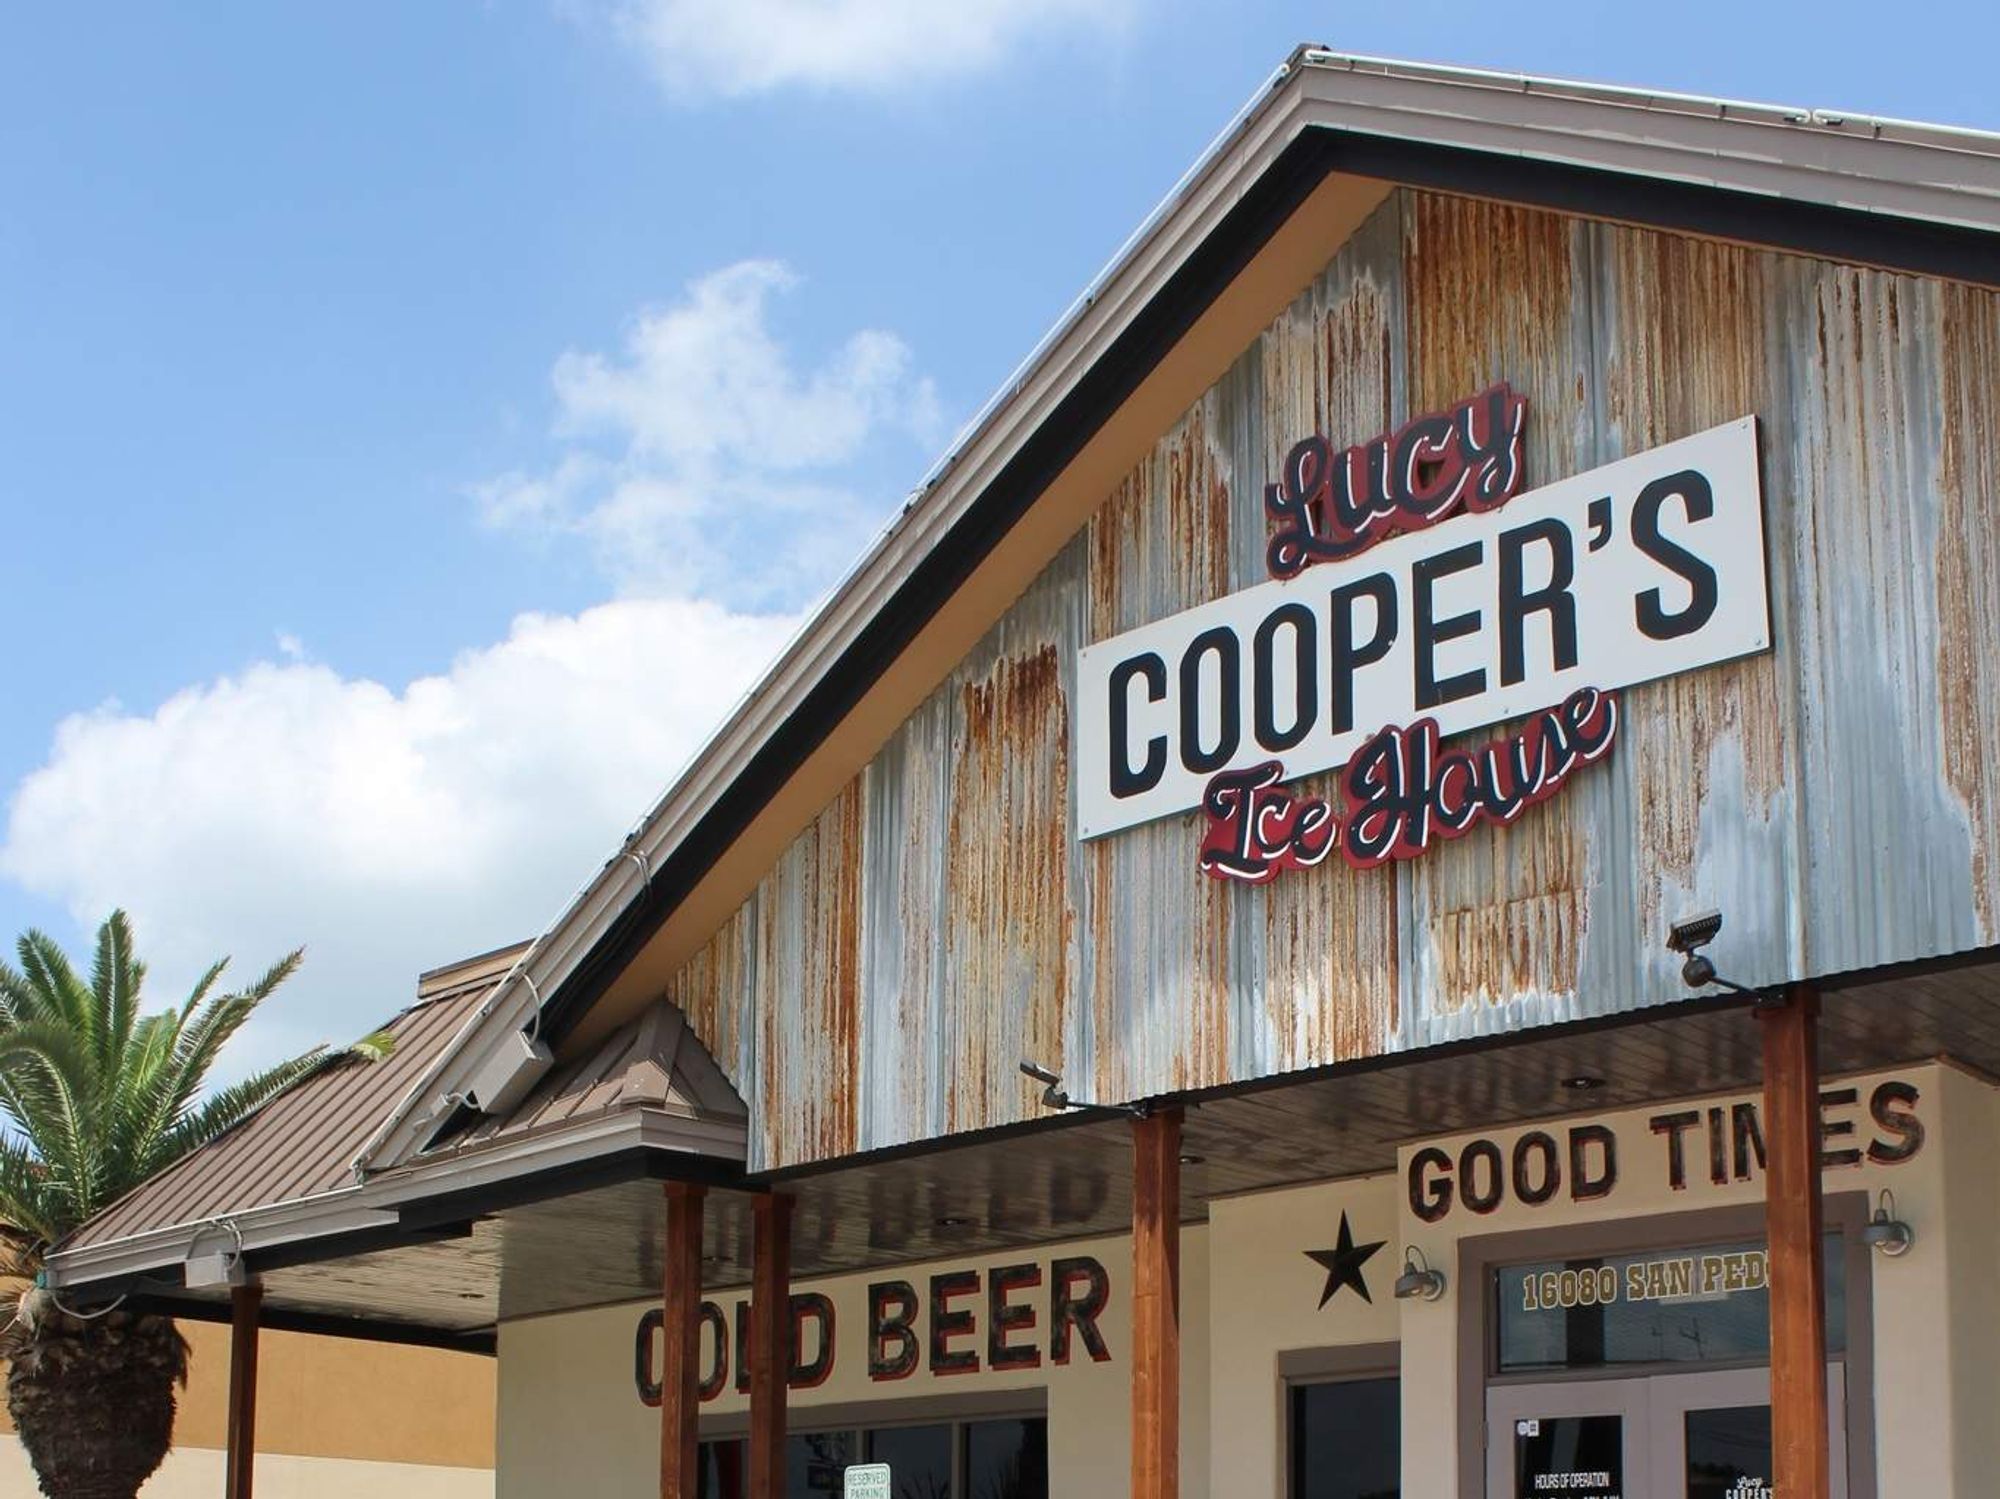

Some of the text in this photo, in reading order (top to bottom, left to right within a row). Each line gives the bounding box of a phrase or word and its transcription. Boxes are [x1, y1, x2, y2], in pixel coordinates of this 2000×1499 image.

[1109, 468, 1719, 800] COOPER'S
[1200, 686, 1618, 884] Ice House
[1408, 1124, 1618, 1223] GOOD
[867, 1255, 1111, 1382] BEER
[1523, 1250, 1770, 1311] 16080 SAN PED
[847, 1471, 888, 1486] RESERVED
[850, 1487, 885, 1499] PARKING
[1535, 1472, 1610, 1489] HOURS OF OPERATION
